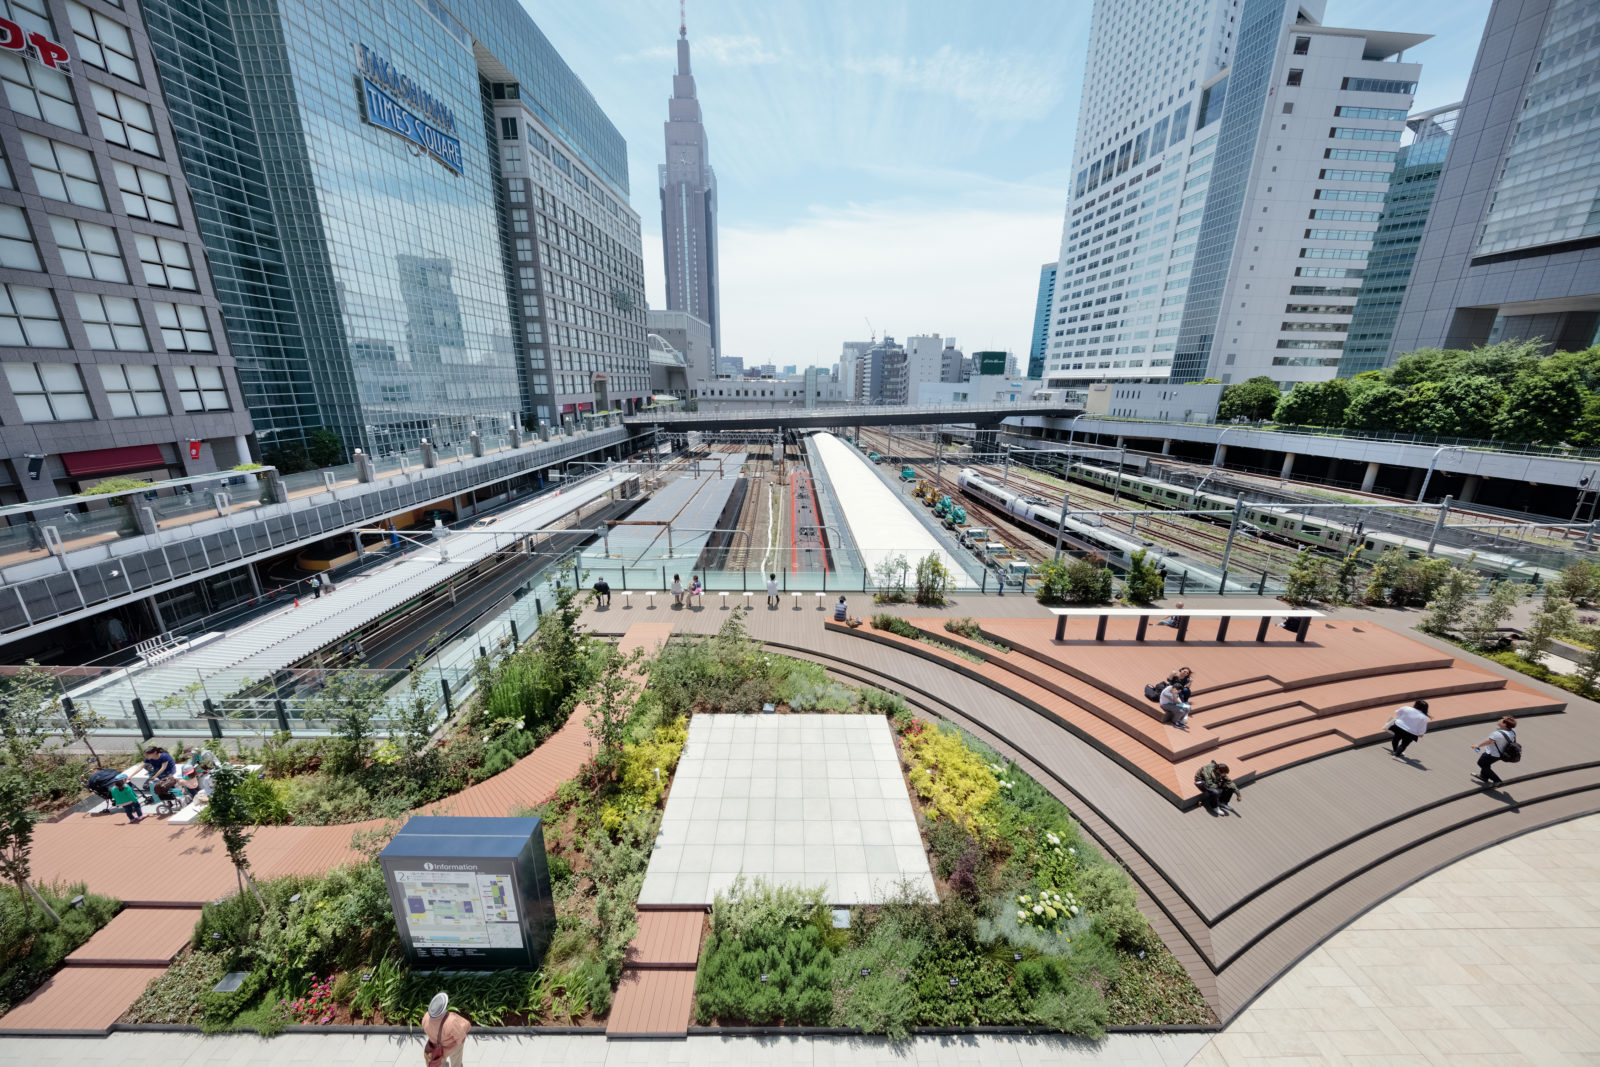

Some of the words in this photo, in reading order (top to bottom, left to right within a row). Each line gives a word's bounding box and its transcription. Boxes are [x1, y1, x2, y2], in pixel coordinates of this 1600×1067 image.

[360, 43, 457, 134] TAKASHIMAYA
[367, 87, 411, 135] TIMES
[413, 118, 462, 167] SQUARE
